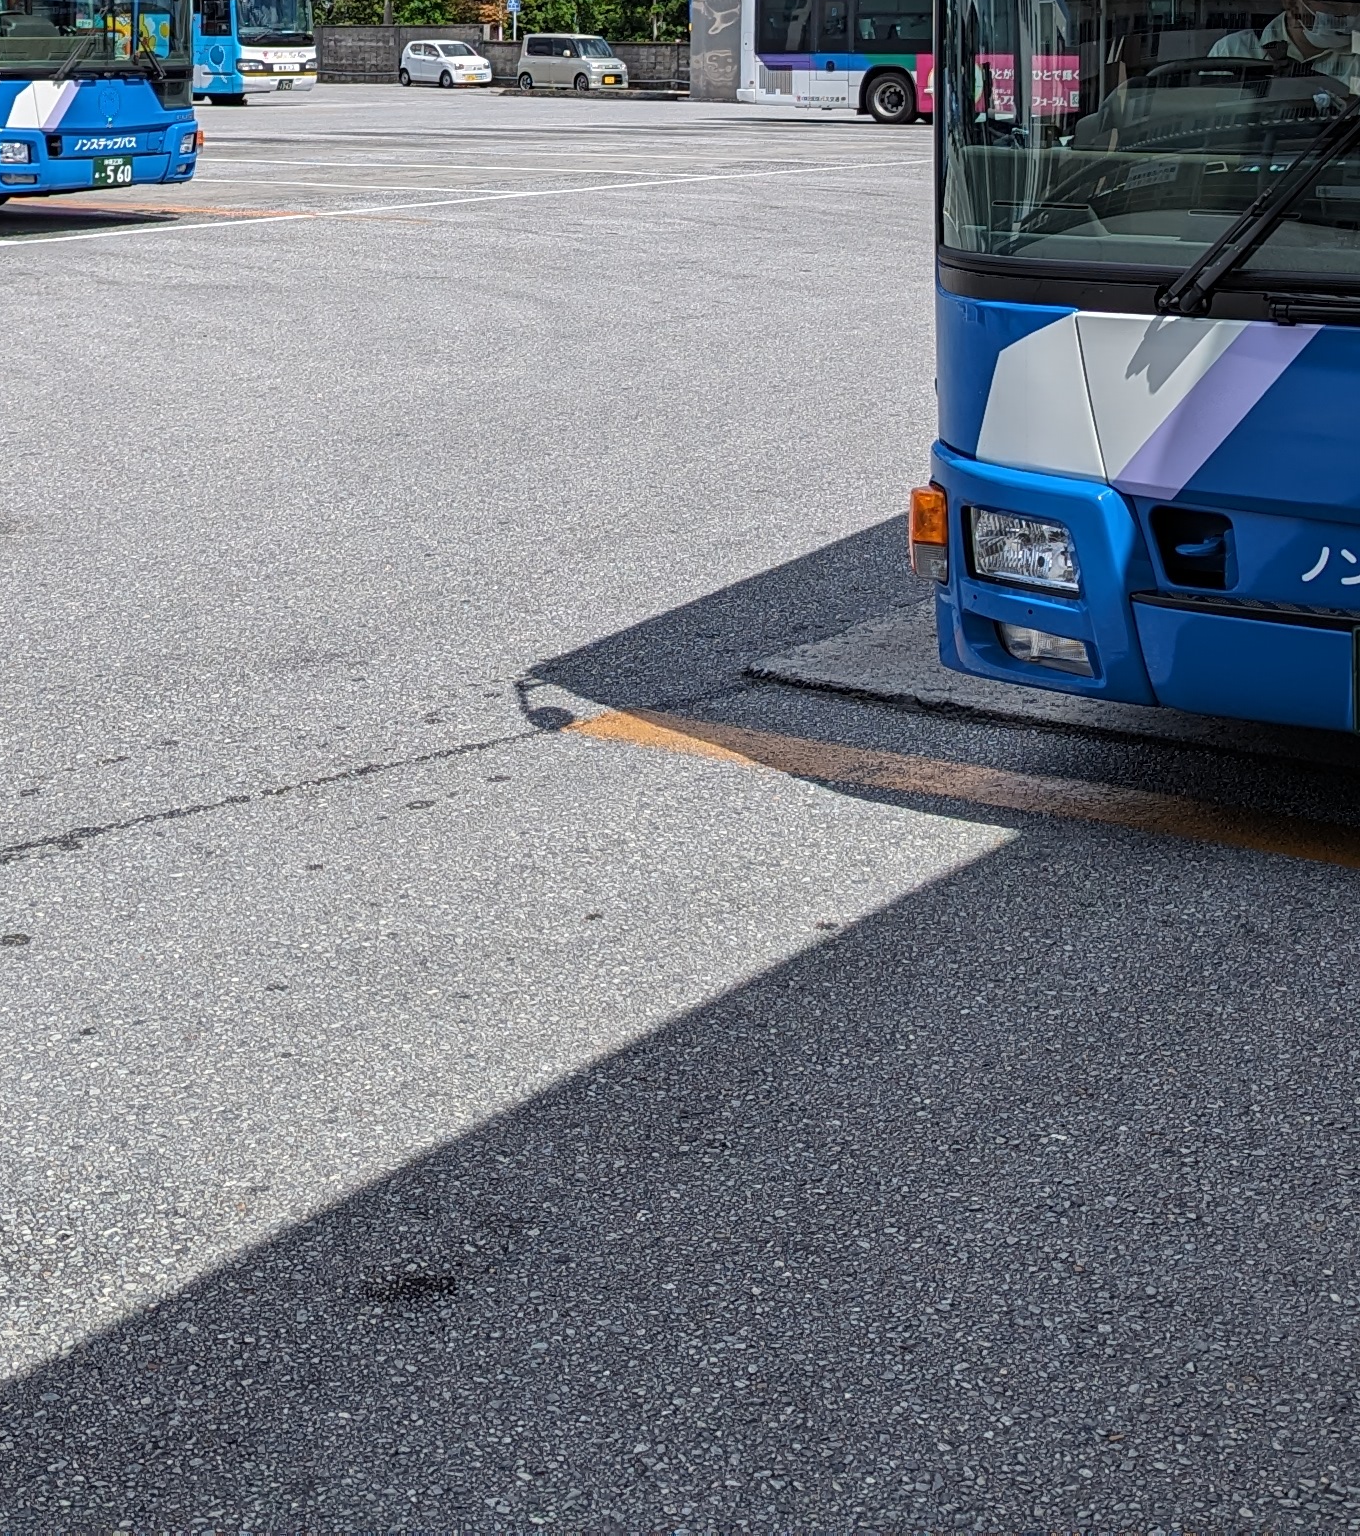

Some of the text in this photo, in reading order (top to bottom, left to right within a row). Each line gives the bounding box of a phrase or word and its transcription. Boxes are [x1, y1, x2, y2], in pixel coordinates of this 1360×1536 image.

[73, 136, 137, 151] ノンステップバス
